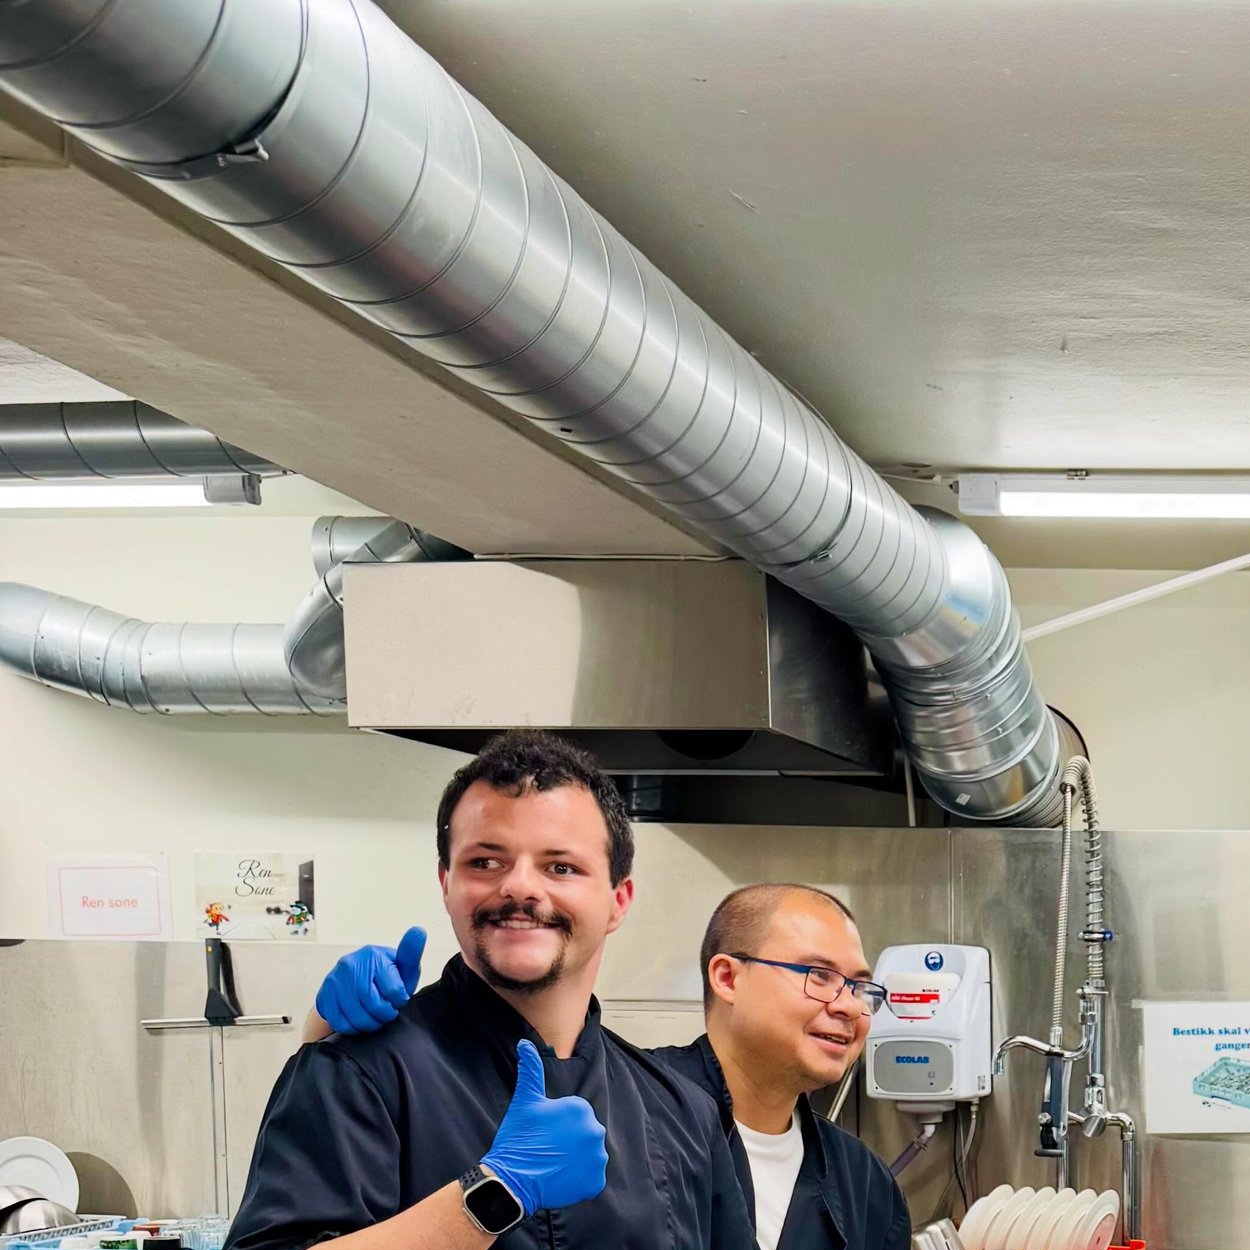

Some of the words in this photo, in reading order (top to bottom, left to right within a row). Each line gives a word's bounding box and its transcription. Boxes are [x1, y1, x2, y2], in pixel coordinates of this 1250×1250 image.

[237, 860, 272, 879] Ren
[235, 877, 275, 897] Sone
[81, 896, 104, 909] Ren
[108, 897, 138, 909] sone
[1172, 1027, 1215, 1036] Bestikk
[1218, 1026, 1242, 1036] skal
[895, 1056, 930, 1064] ECOLAB
